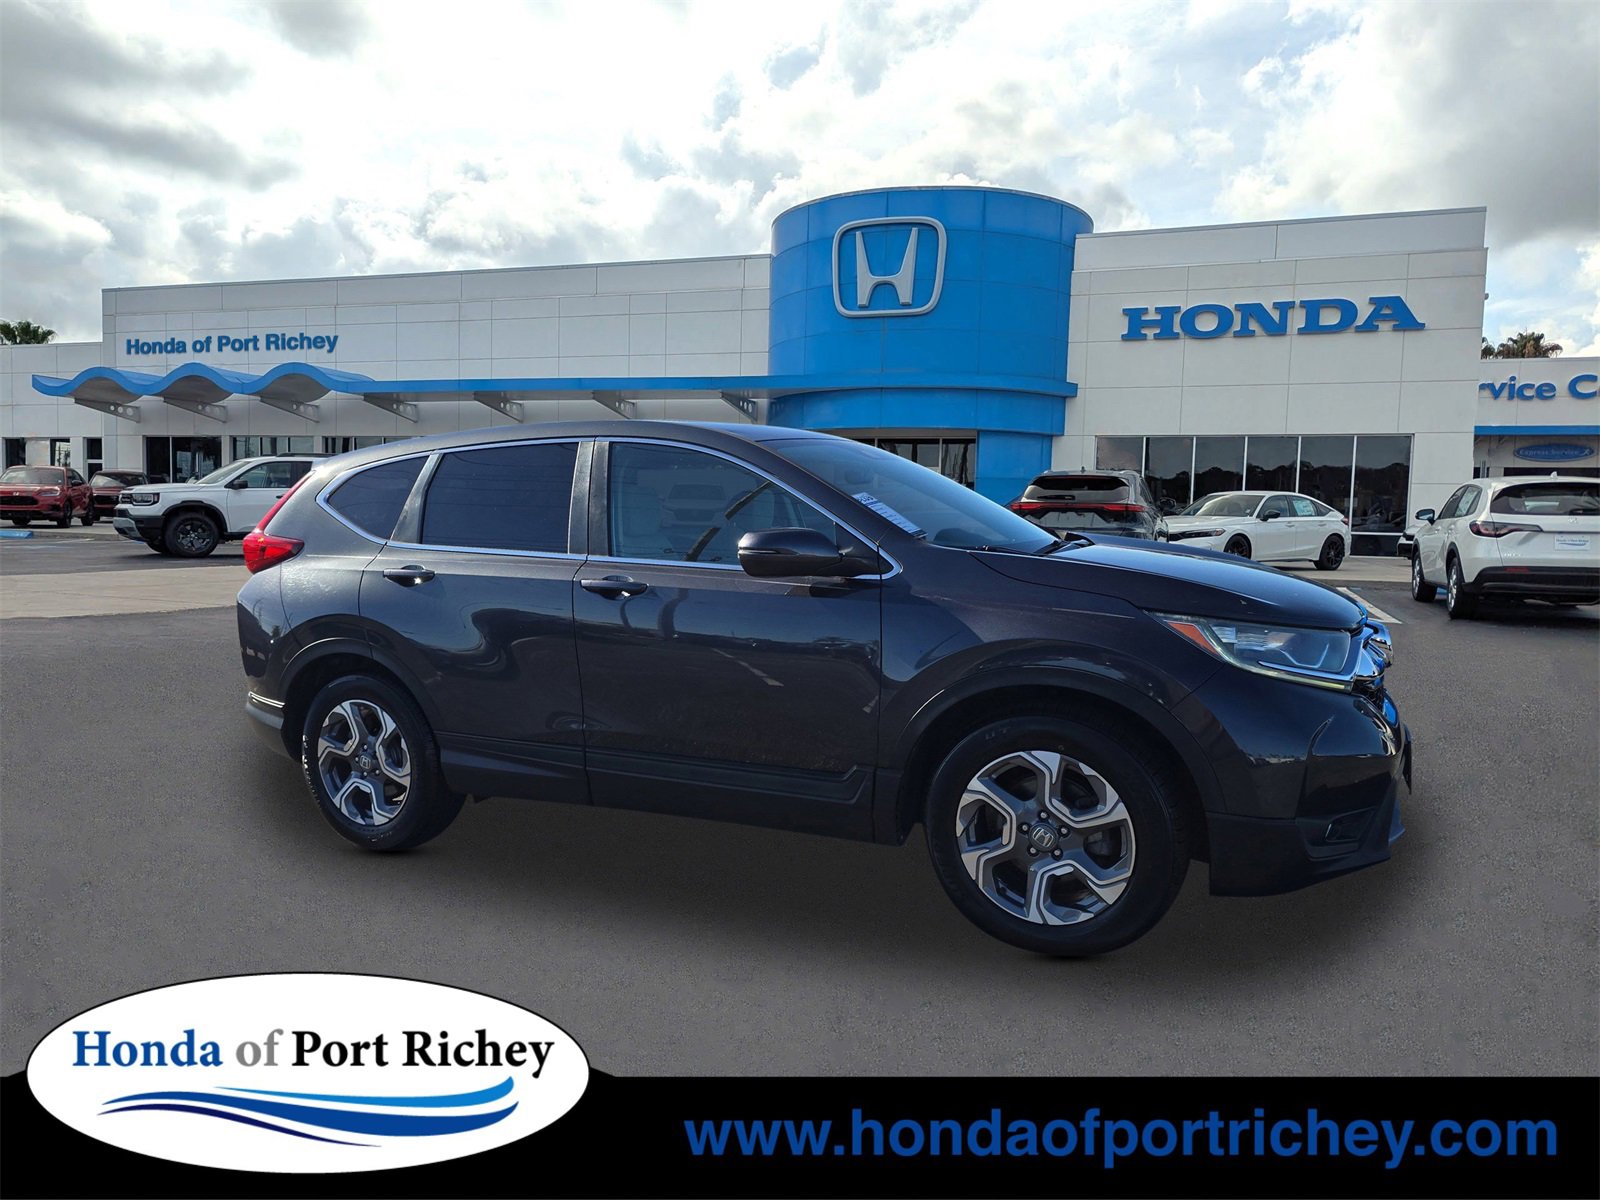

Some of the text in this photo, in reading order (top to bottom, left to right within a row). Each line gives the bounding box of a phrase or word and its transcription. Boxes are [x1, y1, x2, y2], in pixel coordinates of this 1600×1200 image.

[1120, 295, 1426, 341] HONDA
[126, 332, 339, 355] Honda of Port Richey
[1567, 373, 1600, 400] C
